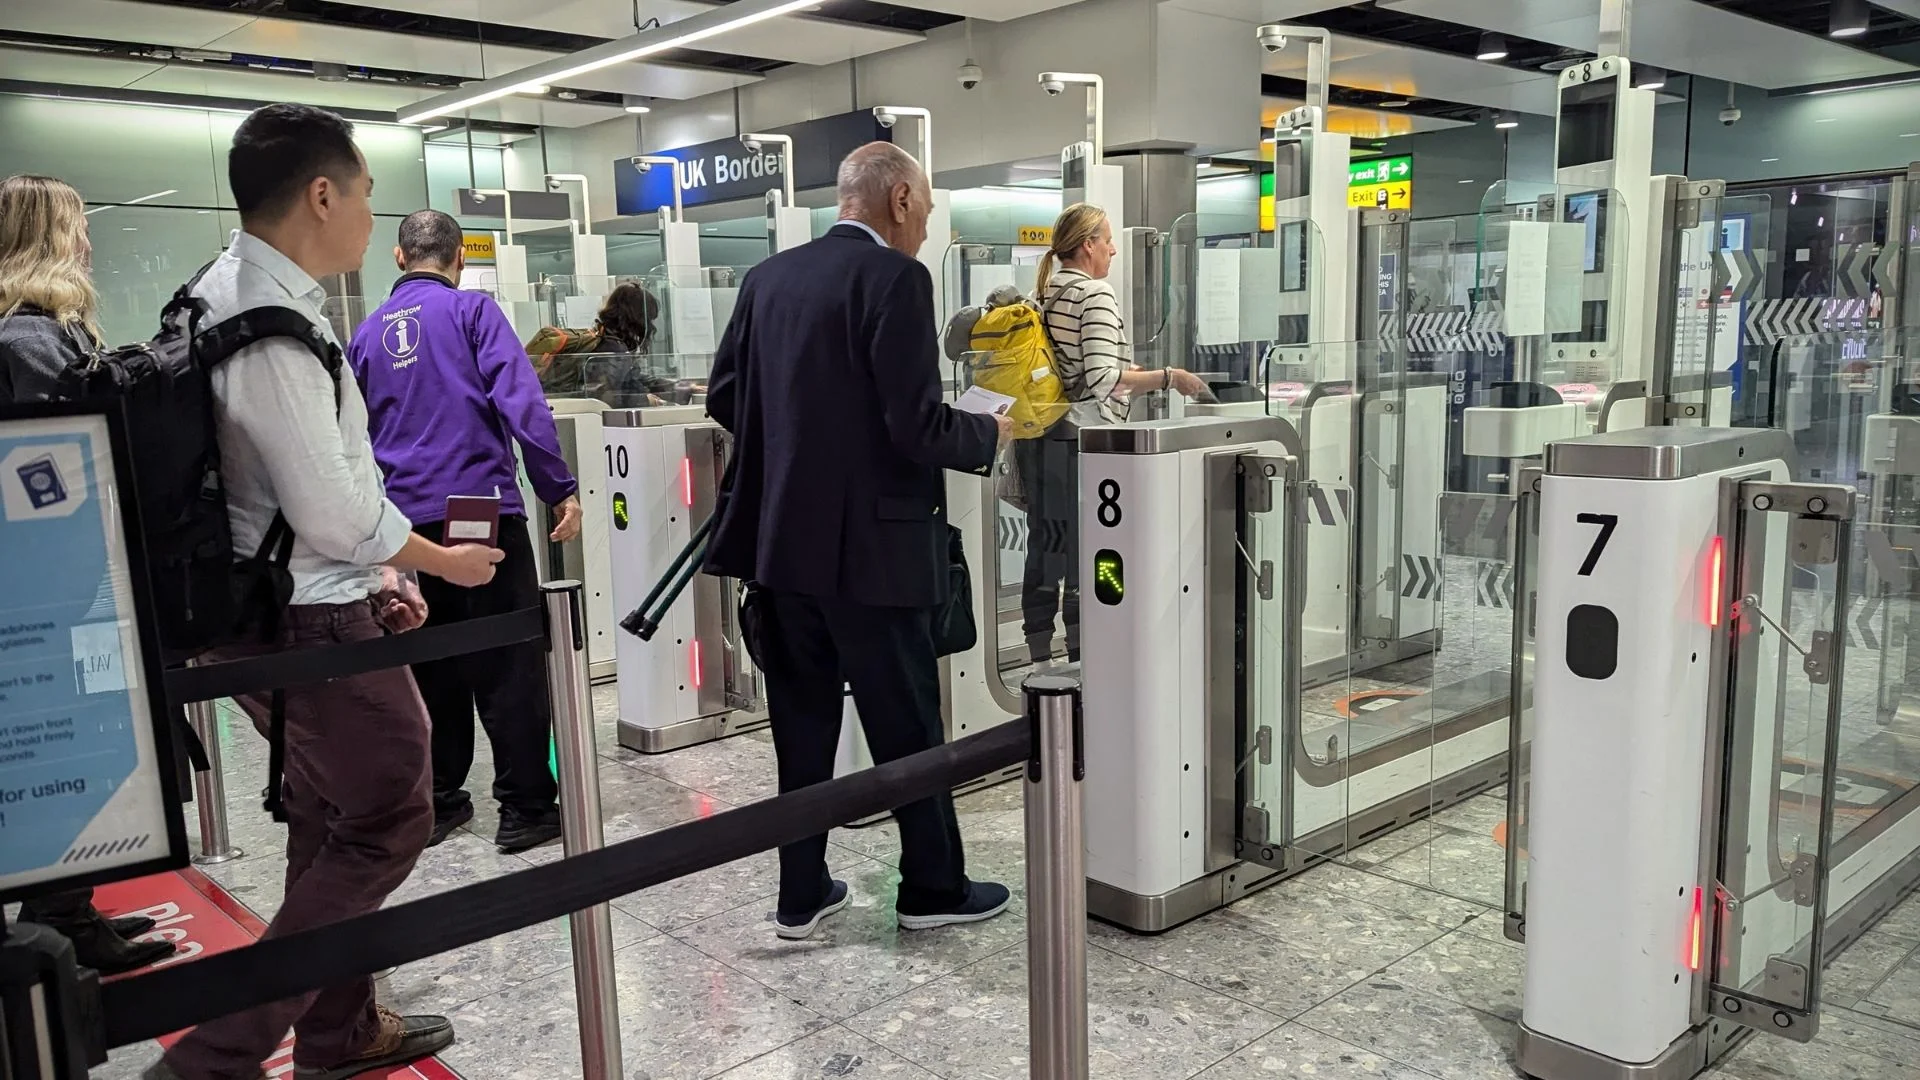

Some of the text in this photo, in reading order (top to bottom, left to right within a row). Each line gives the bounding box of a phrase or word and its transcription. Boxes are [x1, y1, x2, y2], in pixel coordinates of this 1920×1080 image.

[1583, 63, 1591, 82] 8
[680, 158, 707, 190] UK
[1355, 168, 1375, 180] exit
[1353, 191, 1374, 202] Exit
[462, 243, 492, 252] ntrol
[382, 304, 423, 323] Heathrow
[392, 355, 418, 371] Helpers
[604, 444, 629, 479] 10
[1097, 478, 1123, 528] 8
[1576, 512, 1619, 577] 7
[11, 722, 44, 735] down
[46, 717, 73, 729] front
[15, 735, 41, 748] hold
[44, 730, 75, 742] firmly
[31, 778, 86, 798] using
